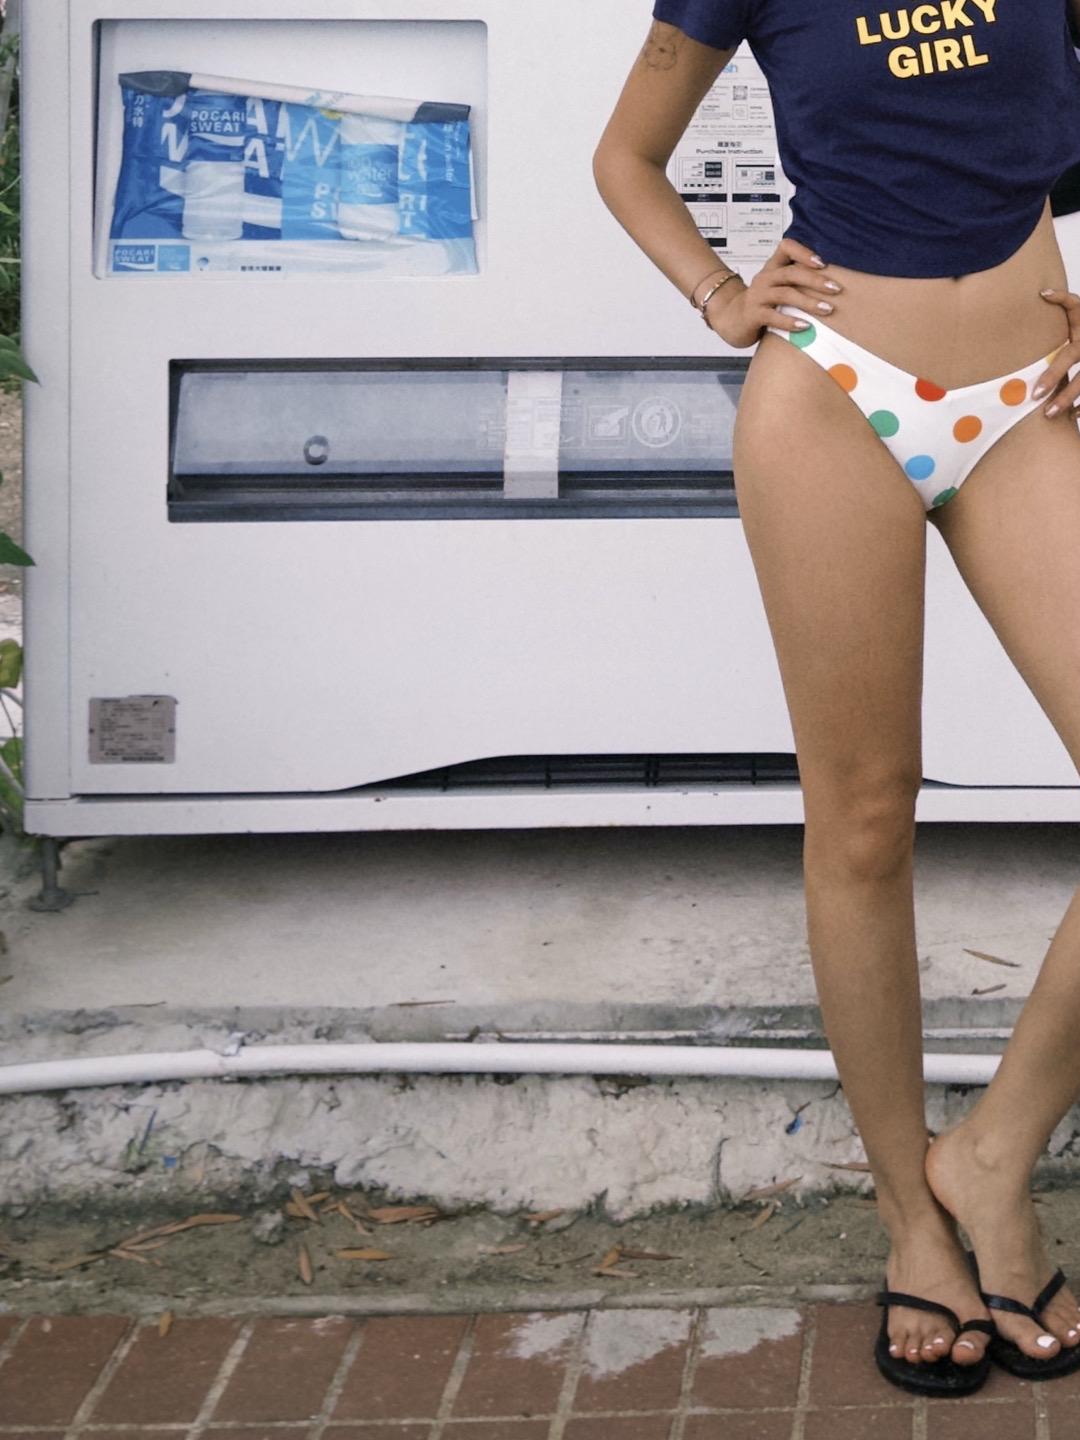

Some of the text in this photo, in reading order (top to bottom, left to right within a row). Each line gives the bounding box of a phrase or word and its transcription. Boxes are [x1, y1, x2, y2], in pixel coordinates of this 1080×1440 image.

[888, 34, 989, 79] GIRL
[190, 109, 246, 123] POCARI
[190, 121, 241, 133] SWEAT
